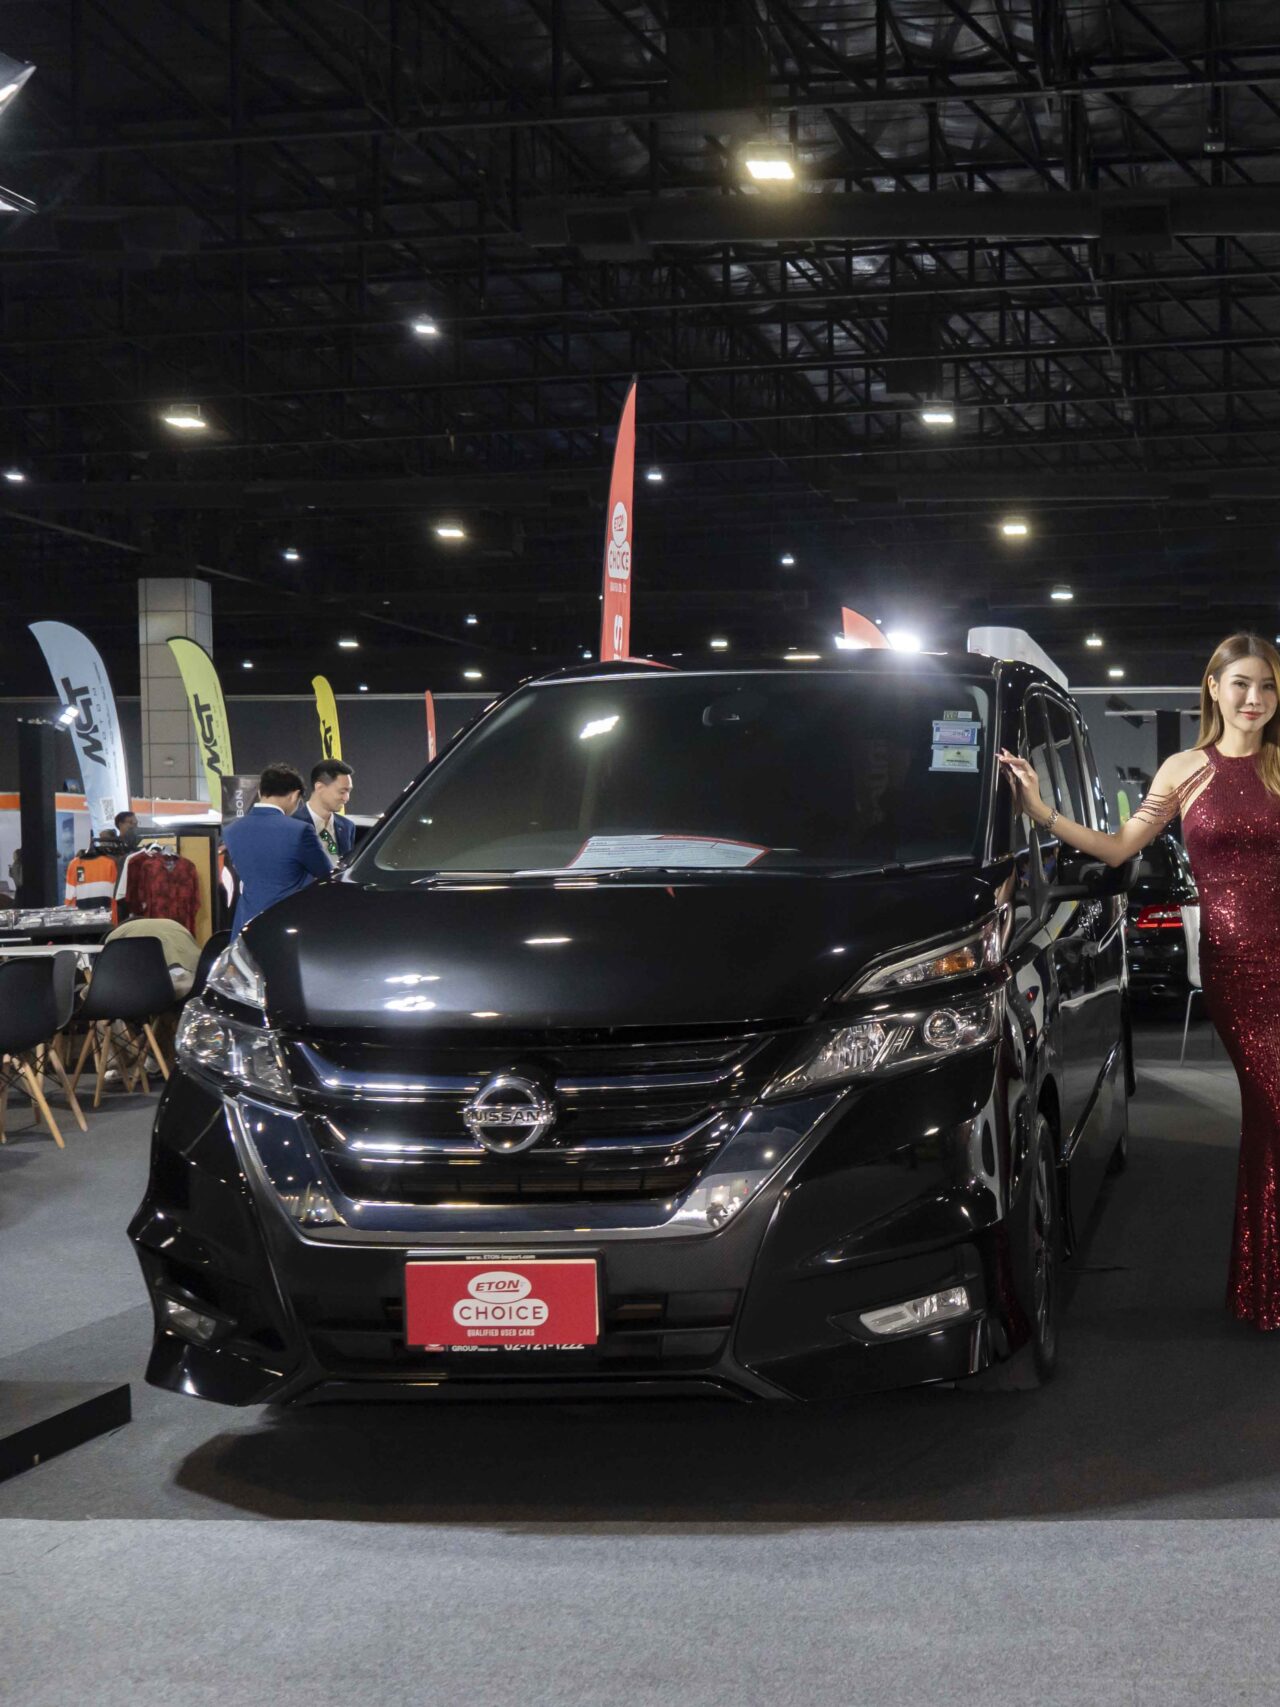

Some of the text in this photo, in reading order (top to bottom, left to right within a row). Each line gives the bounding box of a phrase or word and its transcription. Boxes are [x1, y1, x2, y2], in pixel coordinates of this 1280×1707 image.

[609, 549, 630, 571] CHOICE
[471, 1111, 540, 1122] NISSAN
[475, 1279, 520, 1292] ETON
[459, 1306, 544, 1320] CHOICE
[467, 1328, 535, 1338] QUALIFIED USED CARS
